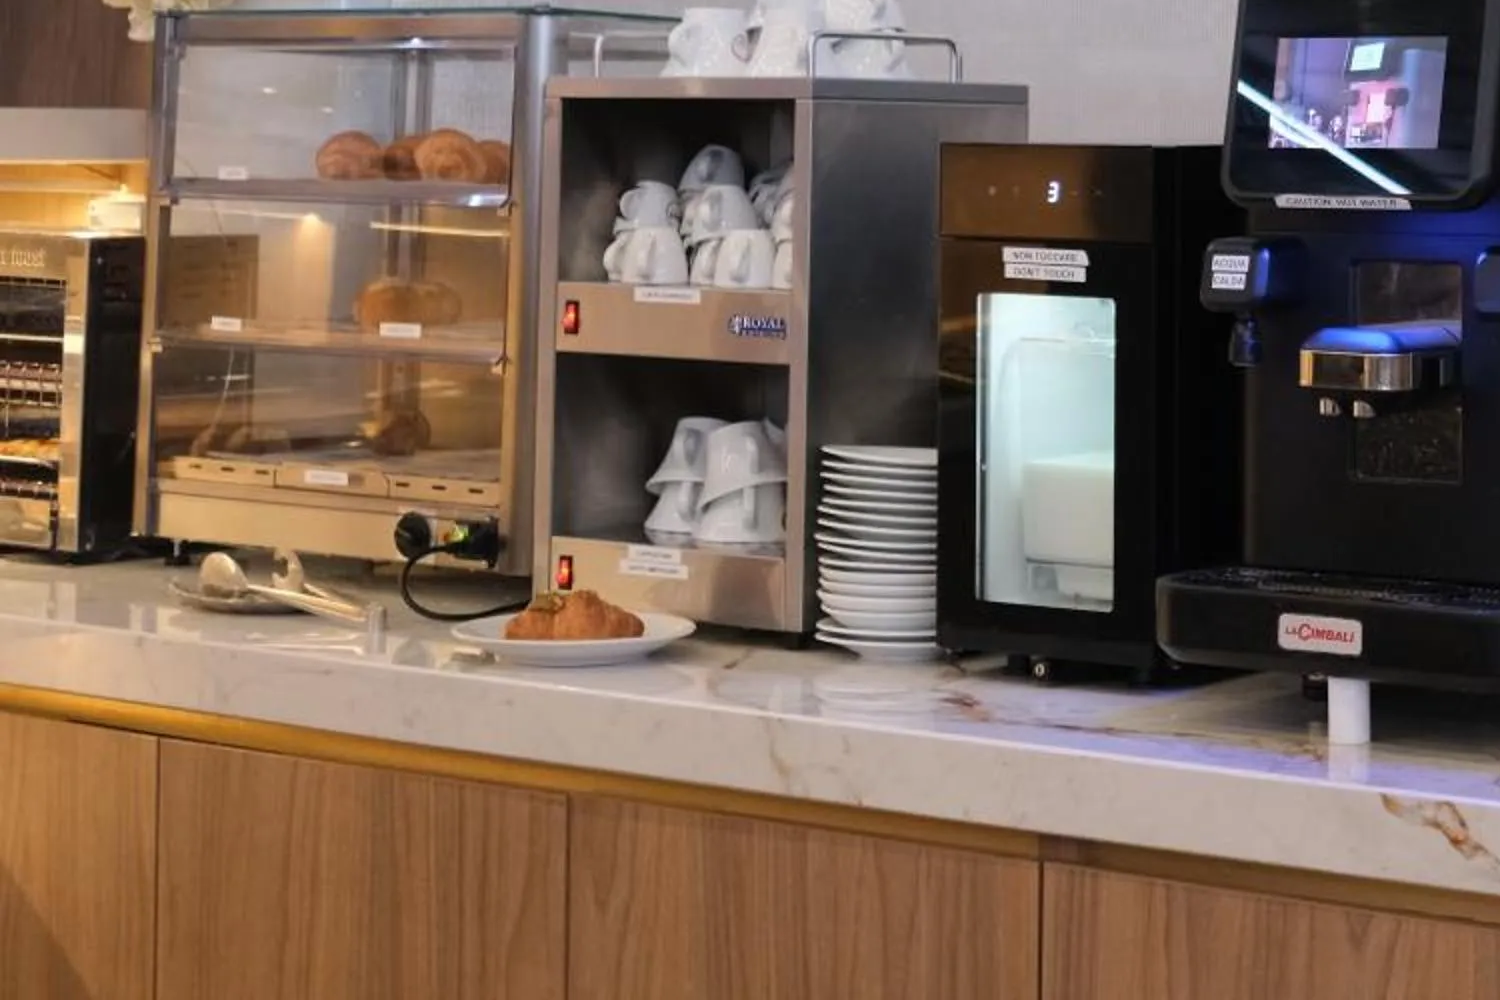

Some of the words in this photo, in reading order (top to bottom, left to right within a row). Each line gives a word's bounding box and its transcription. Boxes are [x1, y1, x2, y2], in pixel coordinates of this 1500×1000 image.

[1047, 181, 1060, 203] 3
[1214, 257, 1247, 269] ACQUA
[1213, 275, 1245, 286] CALDA
[742, 316, 782, 329] ROYAL
